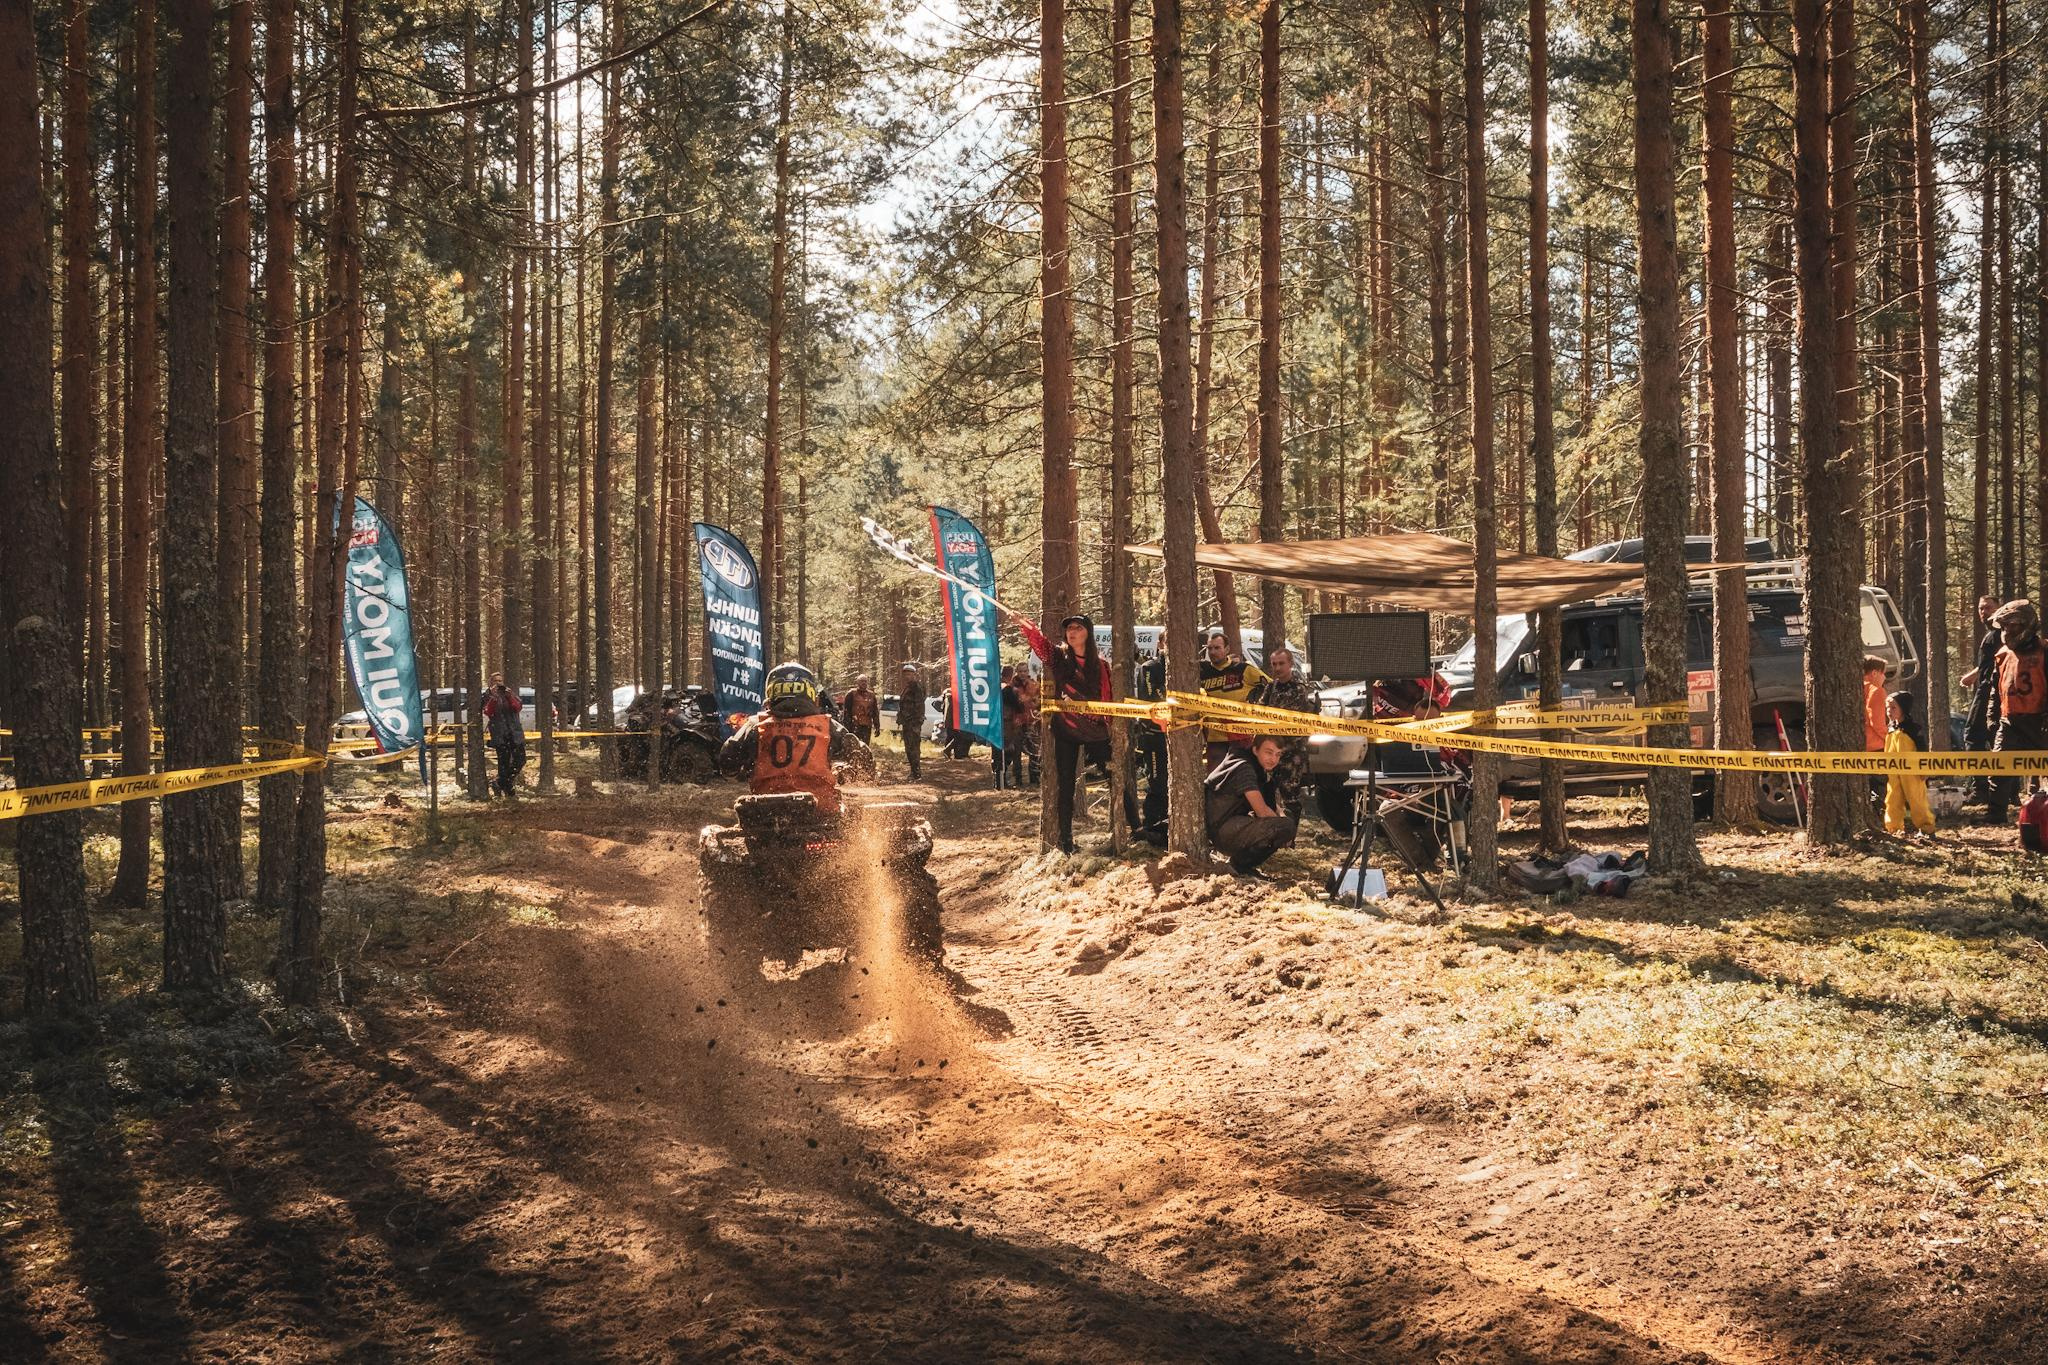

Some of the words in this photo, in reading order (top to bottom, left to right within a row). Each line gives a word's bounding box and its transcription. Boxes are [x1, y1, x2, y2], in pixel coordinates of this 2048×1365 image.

[1556, 713, 1634, 724] FINNTRAIL
[1641, 711, 1689, 721] FINNT
[771, 735, 817, 769] 07
[1251, 709, 1289, 722] FINNTRAIL
[1293, 717, 1334, 729] FINNTRAIL
[1338, 723, 1380, 737] FINNTRAIL
[1385, 730, 1432, 744] FINNTRAIL
[1435, 737, 1484, 750] FINNTRAIL
[1490, 743, 1545, 756] FINNTRAIL
[1549, 748, 1607, 760] FINNTRAIL
[1611, 752, 1674, 764] FINNTRAIL
[1679, 755, 1747, 767] FINNTRAIL
[1752, 757, 1826, 769] FINNTRAIL
[1832, 758, 1911, 770] FINNTRAIL
[1919, 758, 2005, 770] FINNTRAIL
[20, 788, 90, 808] FINNTRAIL
[96, 779, 160, 798] FINNTRAIL
